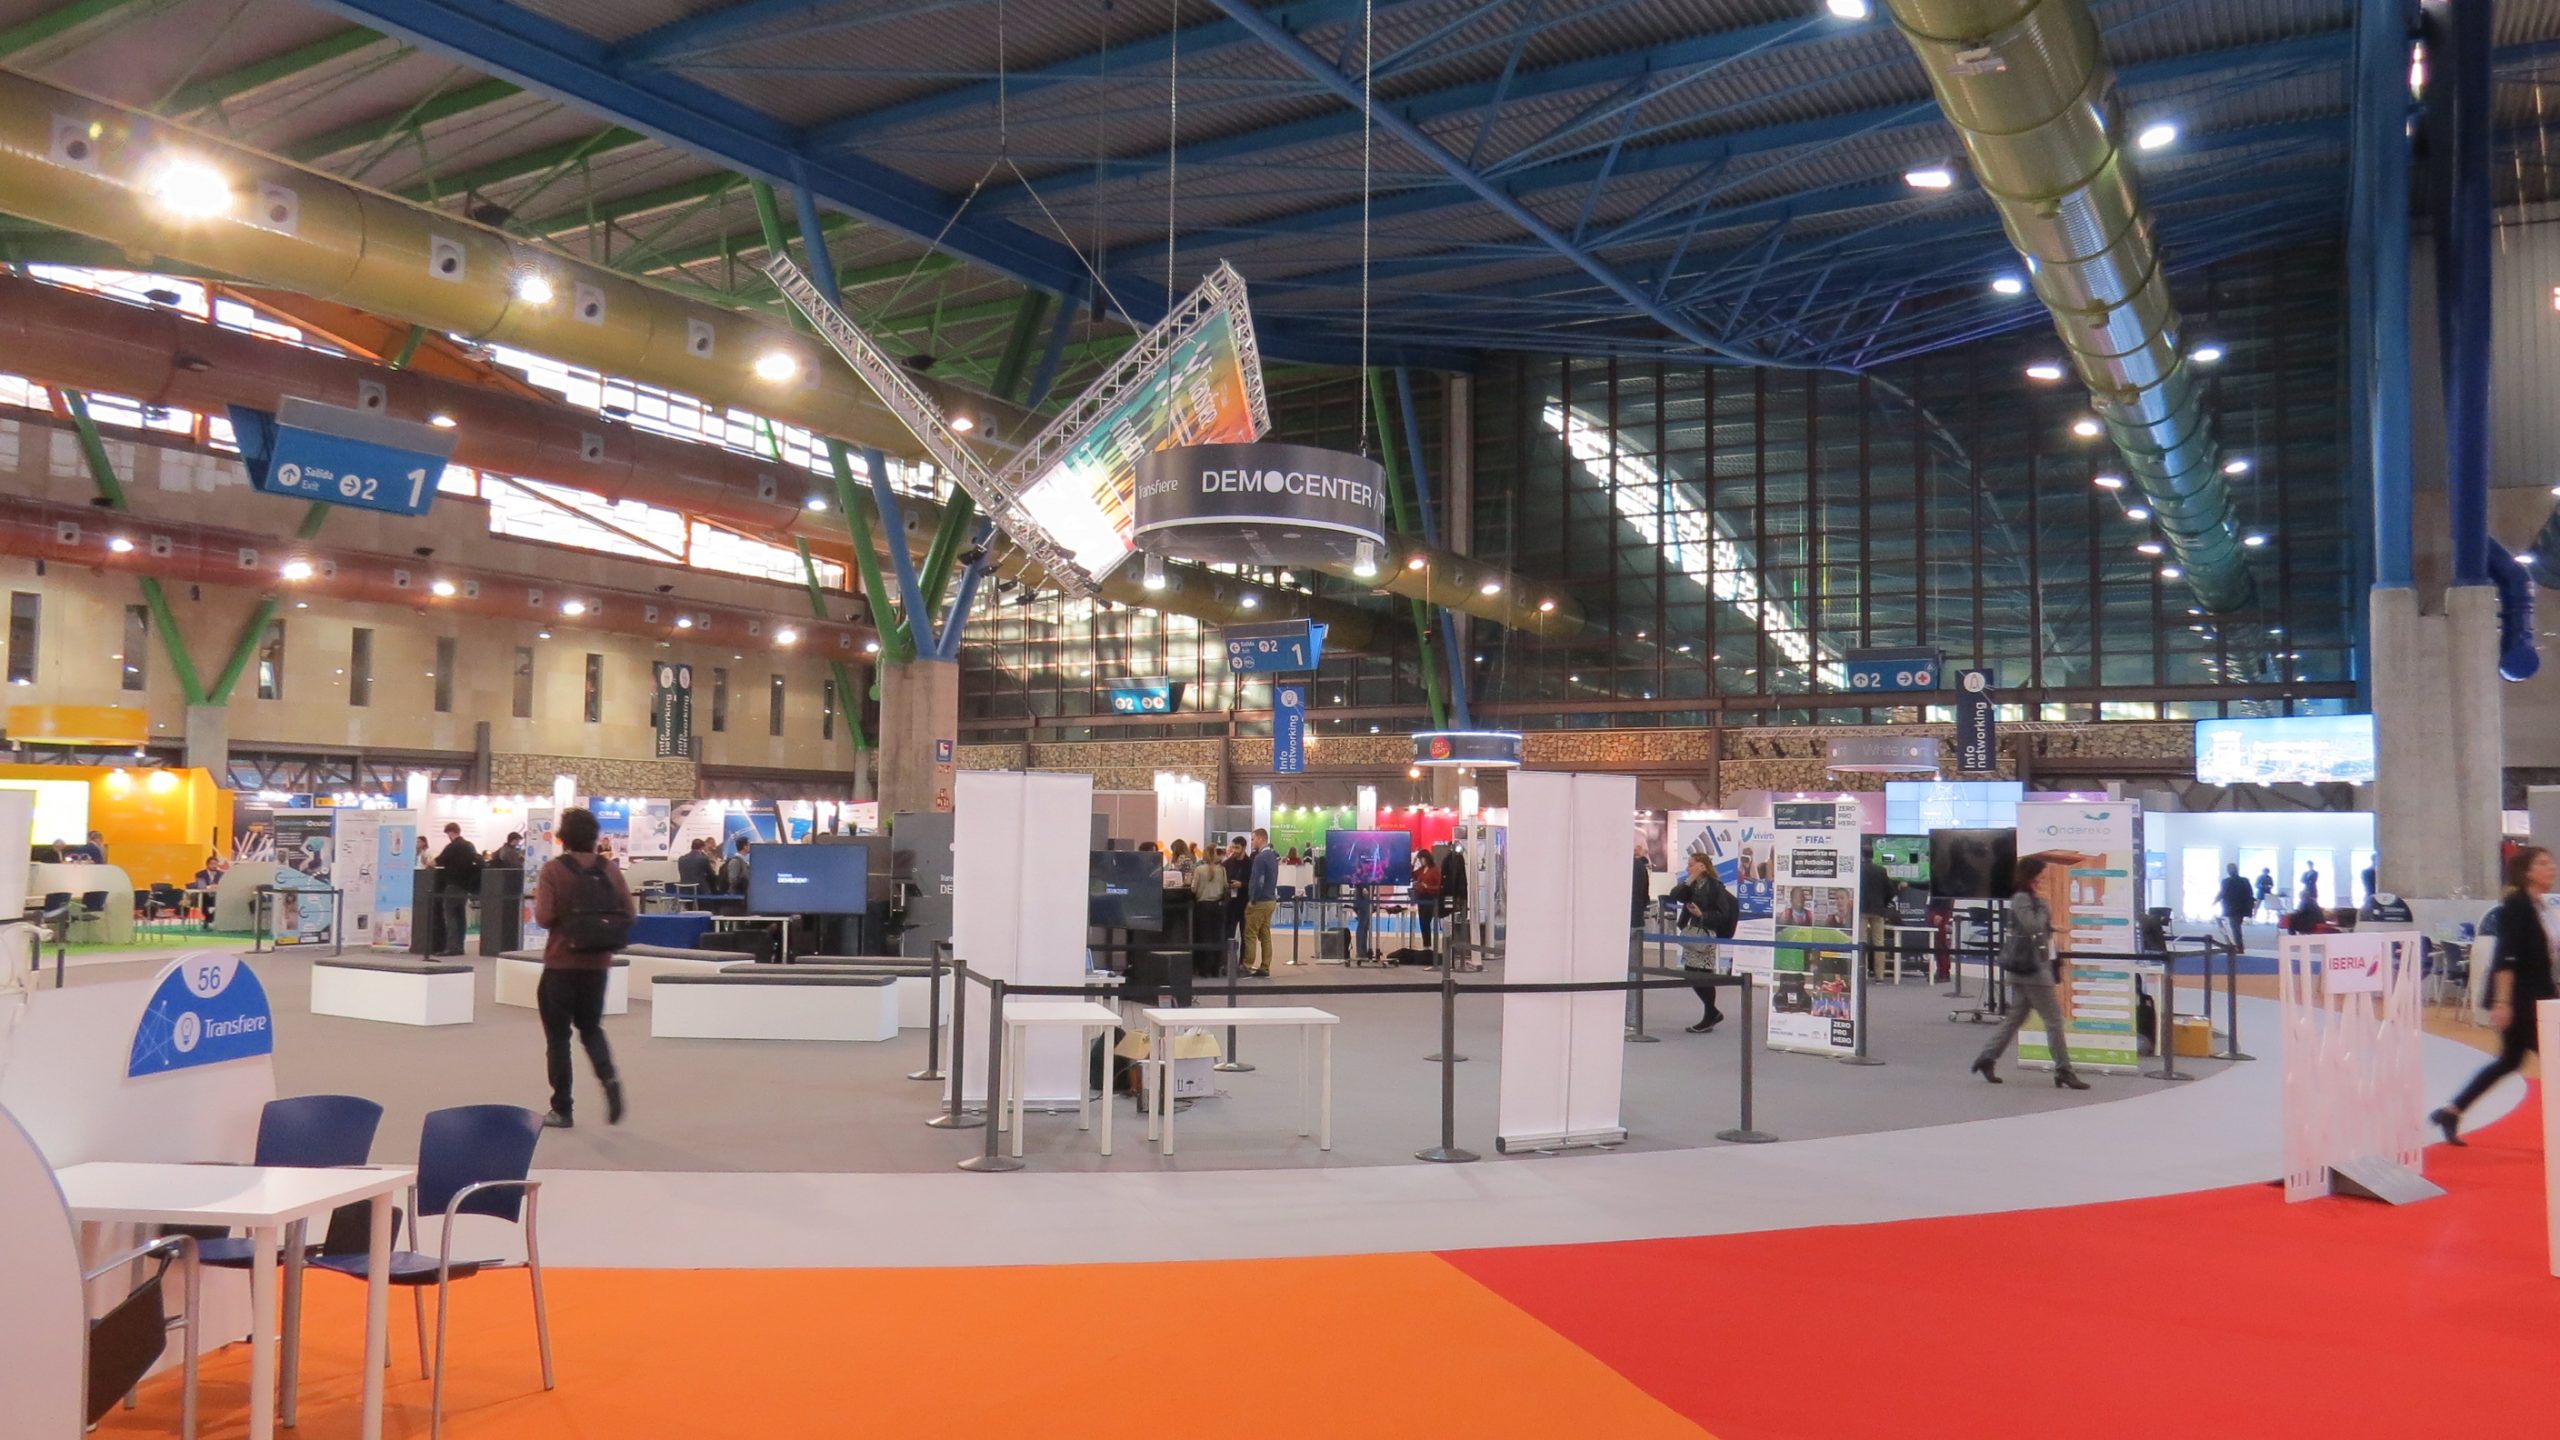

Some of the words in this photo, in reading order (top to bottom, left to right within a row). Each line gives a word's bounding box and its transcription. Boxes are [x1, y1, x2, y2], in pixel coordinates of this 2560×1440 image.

[301, 480, 321, 492] Exit
[304, 466, 334, 481] Salida
[361, 478, 378, 501] 2
[407, 468, 427, 508] 1
[1138, 478, 1178, 500] Transfiere
[1202, 470, 1372, 508] DEMOCENTER
[1270, 640, 1278, 652] 2
[1291, 643, 1303, 666] 1
[1870, 673, 1881, 687] 2
[1126, 698, 1134, 710] 2
[664, 694, 673, 755] networking
[1976, 702, 1987, 768] networking
[1290, 715, 1298, 770] networking
[1280, 751, 1288, 770] Info
[1965, 745, 1975, 768] Info
[1805, 835, 1824, 844] FIFA
[2329, 957, 2365, 970] IBERIA
[198, 966, 221, 991] 56
[204, 1014, 267, 1039] Transfiere
[1833, 1021, 1851, 1029] ZERO
[1833, 1036, 1851, 1044] HERO
